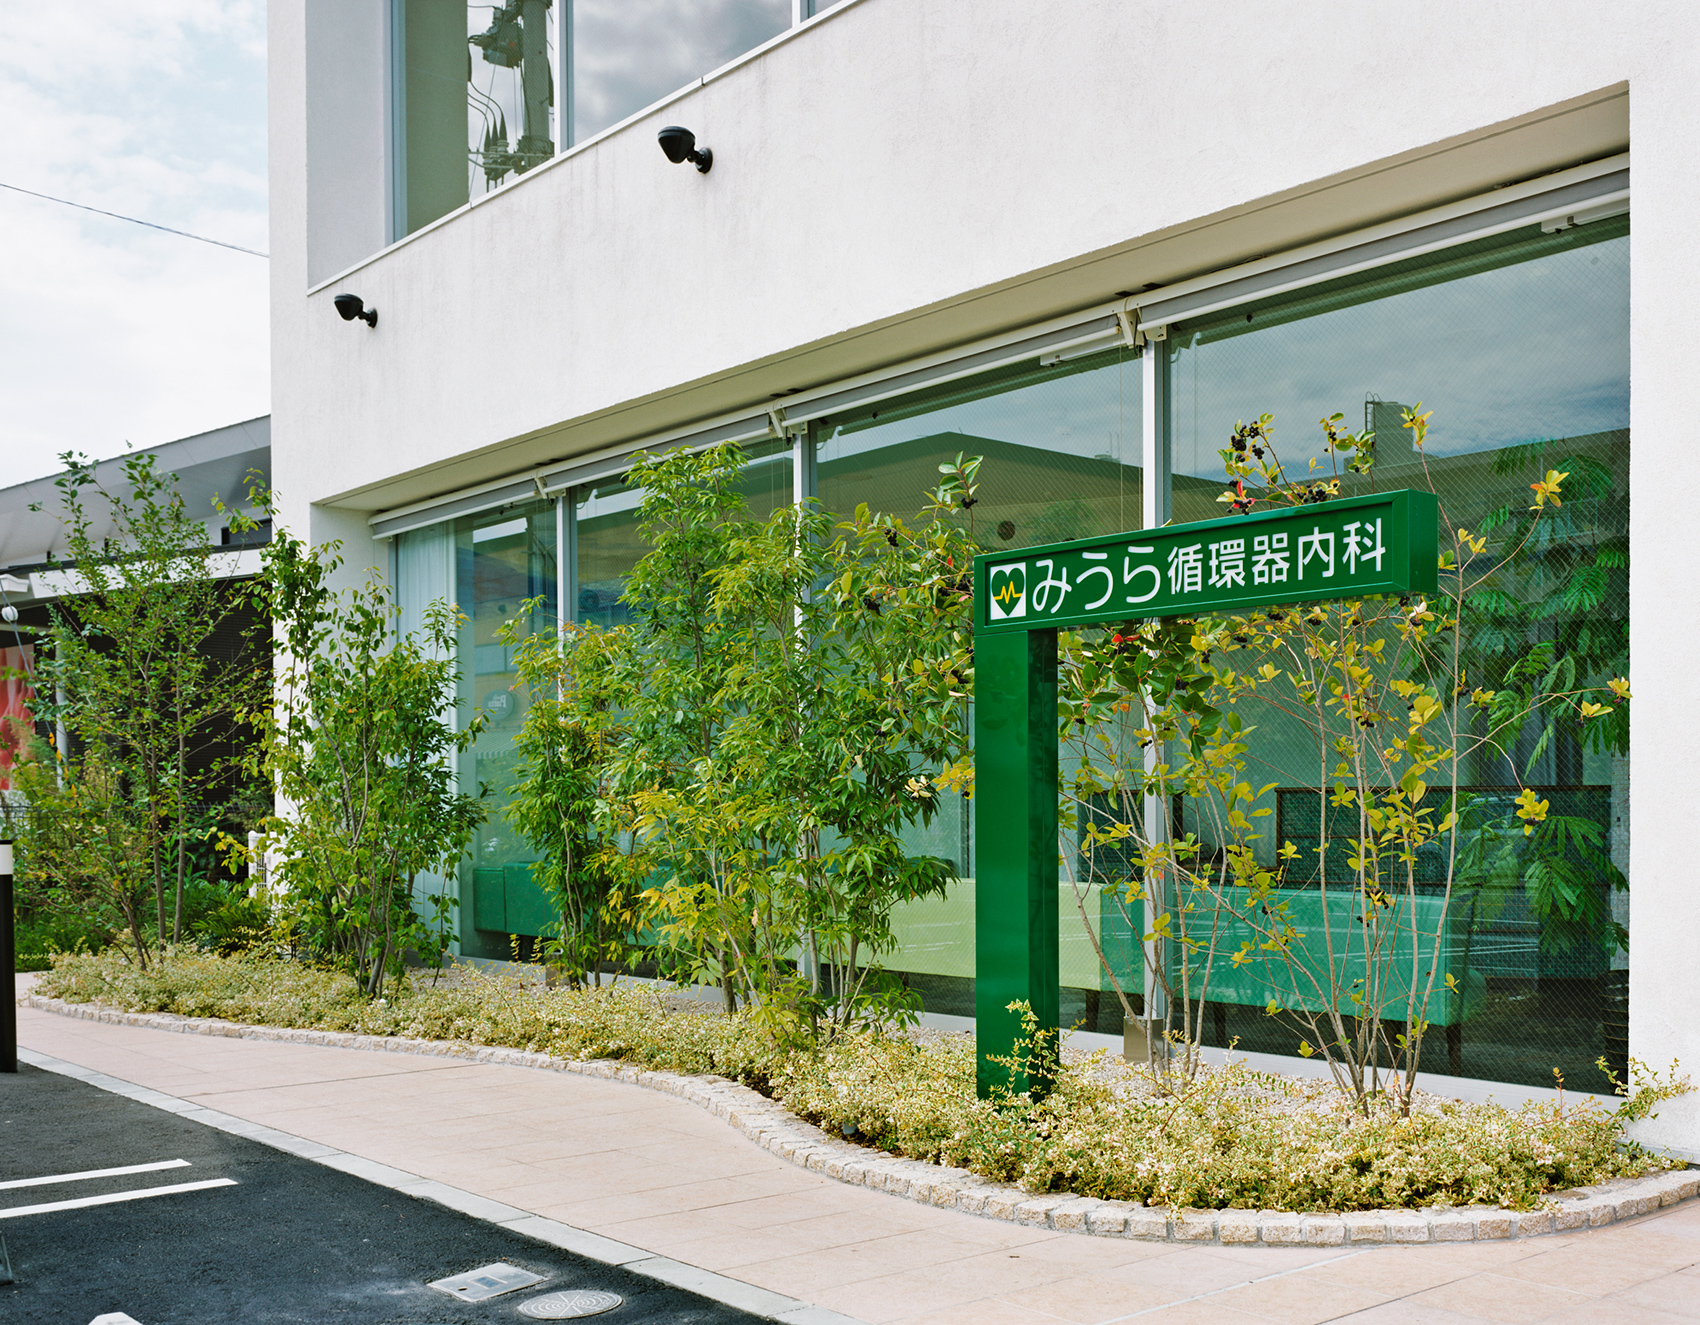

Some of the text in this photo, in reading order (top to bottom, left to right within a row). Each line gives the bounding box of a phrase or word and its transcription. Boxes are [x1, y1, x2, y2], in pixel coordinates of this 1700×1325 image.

[1032, 517, 1386, 614] みうら循環器内科
